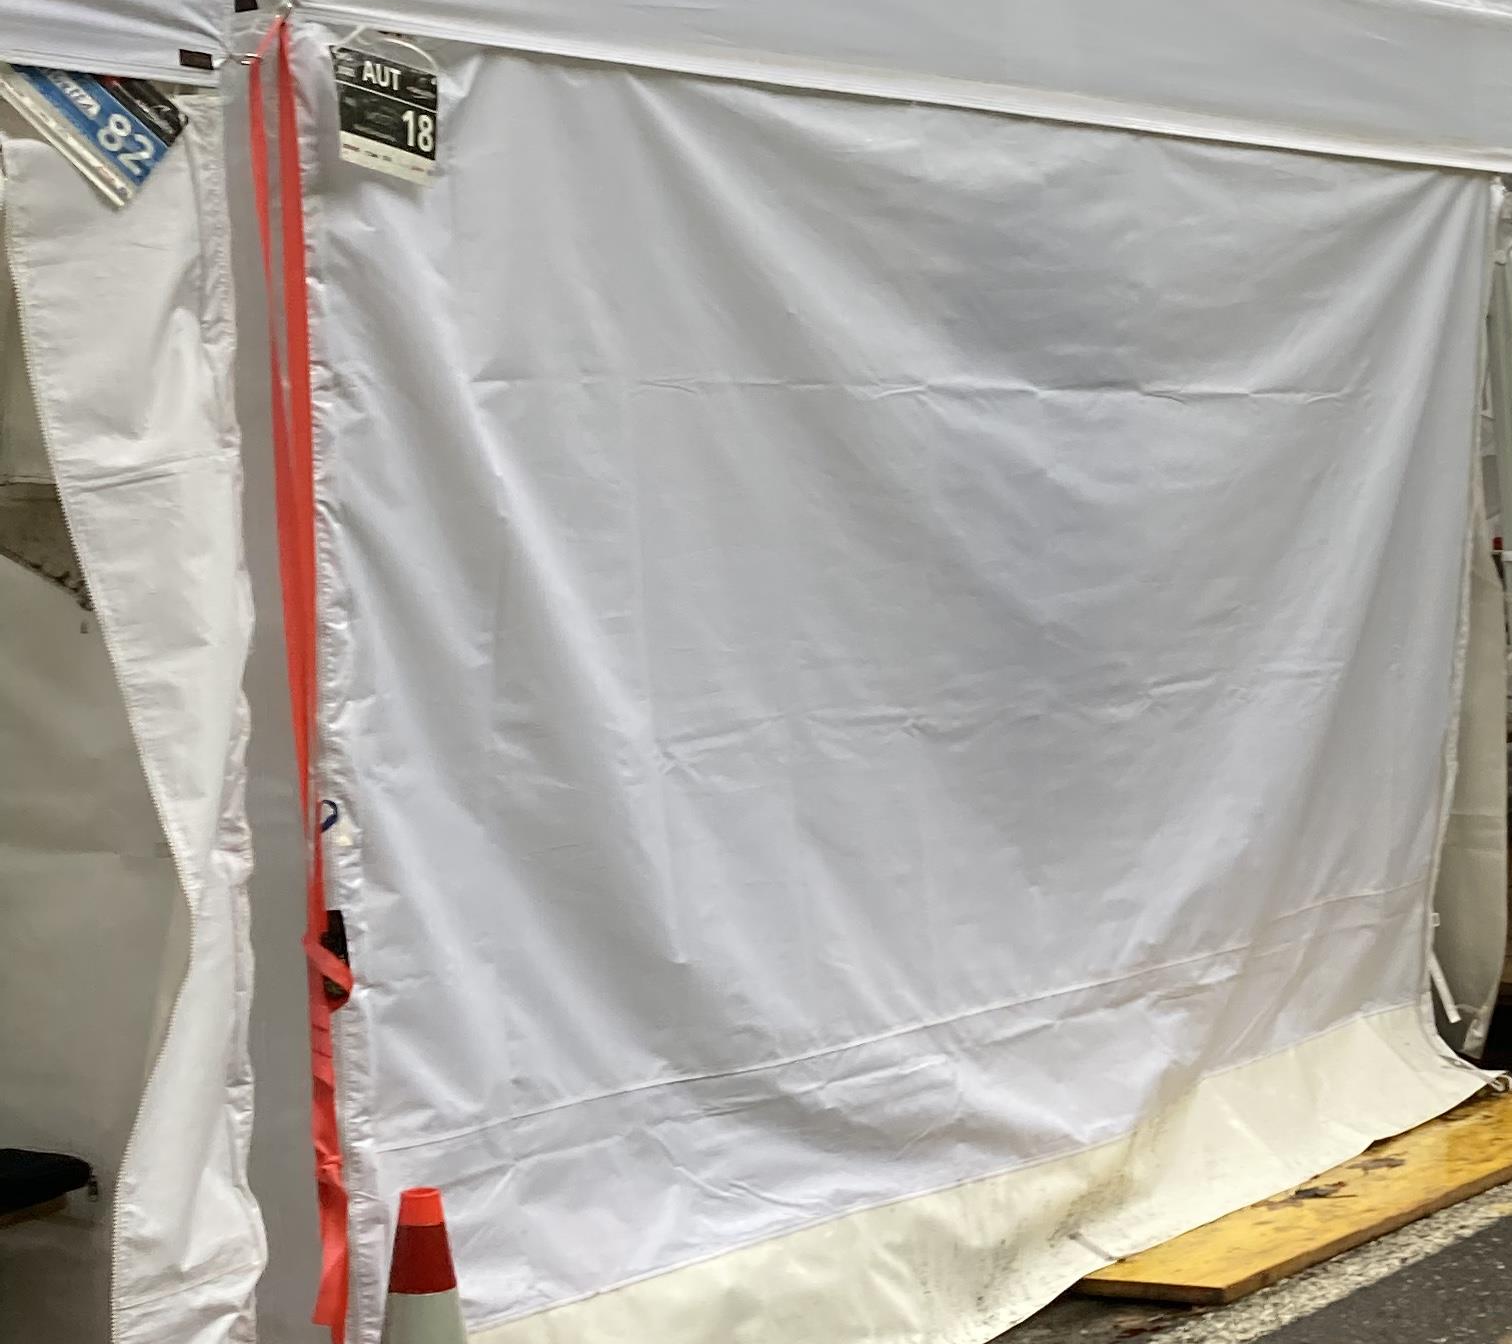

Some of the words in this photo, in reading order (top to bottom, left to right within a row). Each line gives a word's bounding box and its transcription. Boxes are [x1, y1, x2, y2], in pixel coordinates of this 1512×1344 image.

[362, 60, 401, 91] AUT
[97, 113, 154, 175] 82
[402, 110, 434, 152] 18
